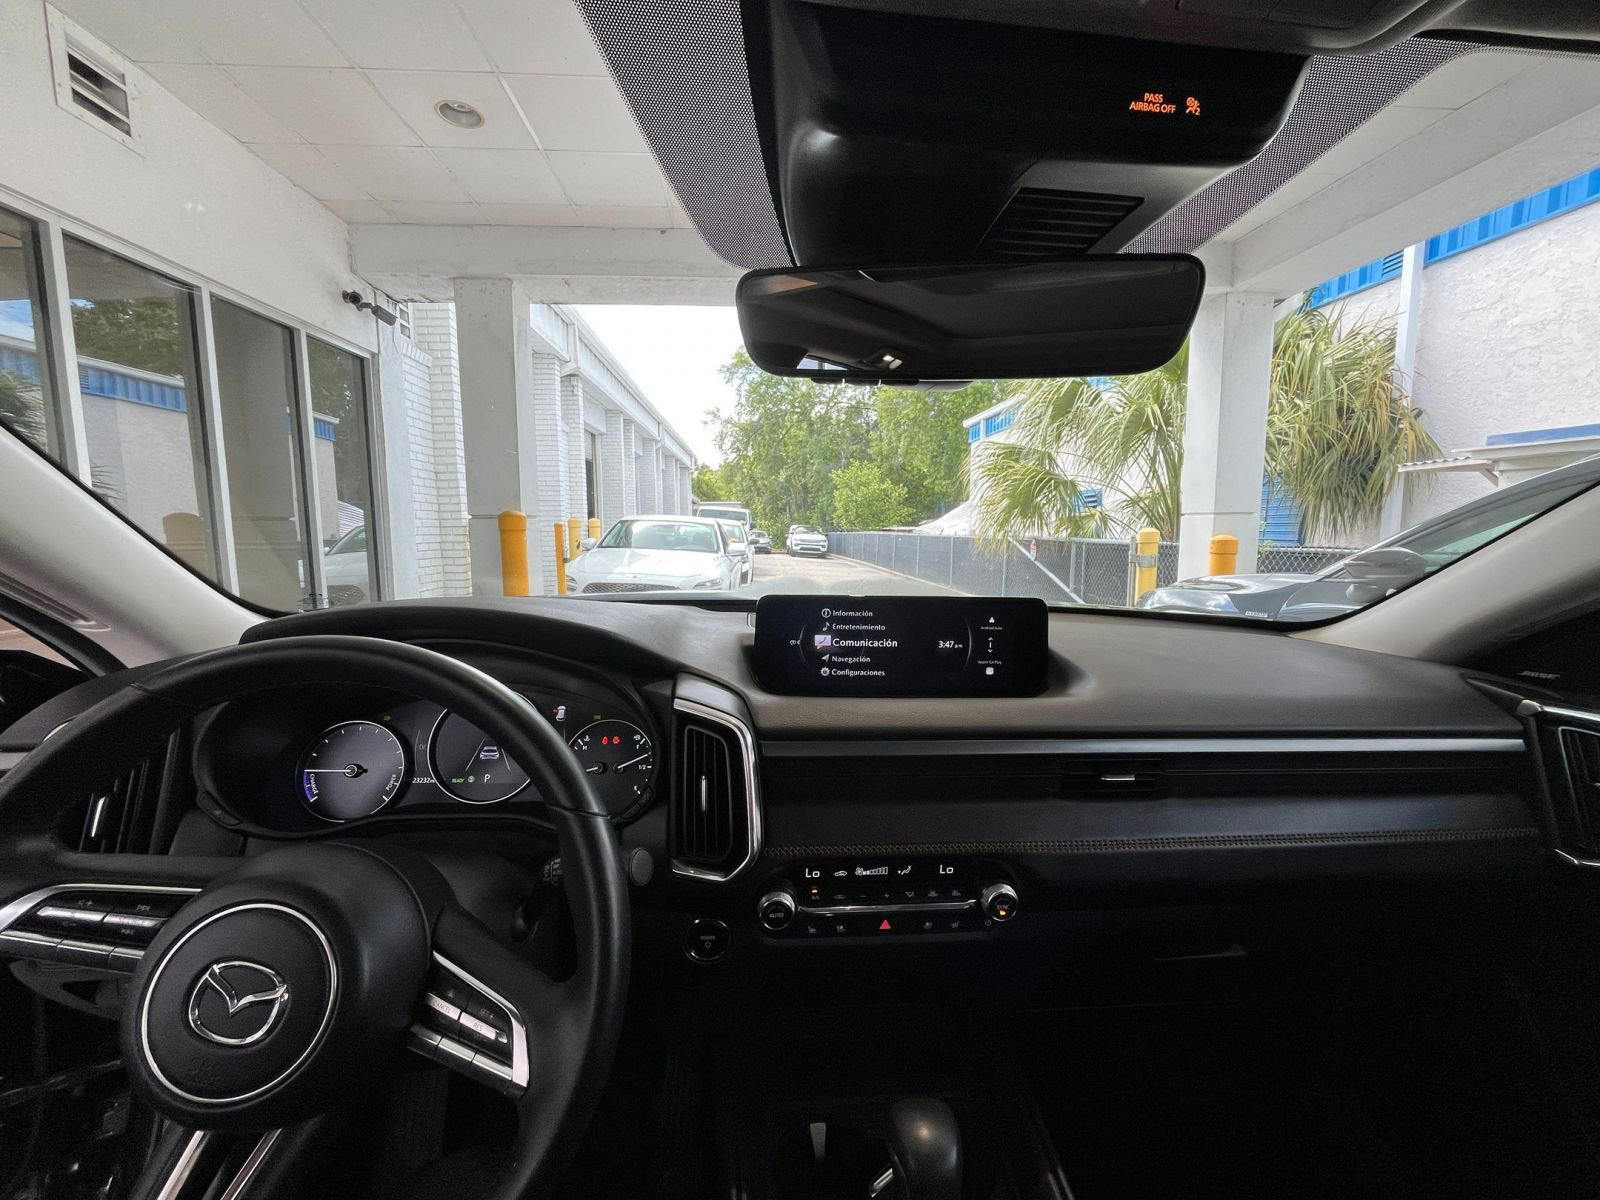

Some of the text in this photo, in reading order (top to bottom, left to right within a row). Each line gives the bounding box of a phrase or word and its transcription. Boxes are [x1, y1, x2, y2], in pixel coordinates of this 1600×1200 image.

[1144, 92, 1164, 102] PASS
[1129, 101, 1176, 114] AIRBAG OFF
[832, 638, 898, 648] Comunicación
[938, 640, 954, 648] 3:47
[832, 656, 870, 664] Navegación
[832, 668, 885, 677] Configuraciones
[385, 774, 397, 791] POWER
[484, 774, 491, 782] P
[309, 773, 320, 794] CHARGE
[805, 867, 820, 878] Lo
[939, 864, 954, 874] Lo
[473, 1022, 482, 1031] RES
